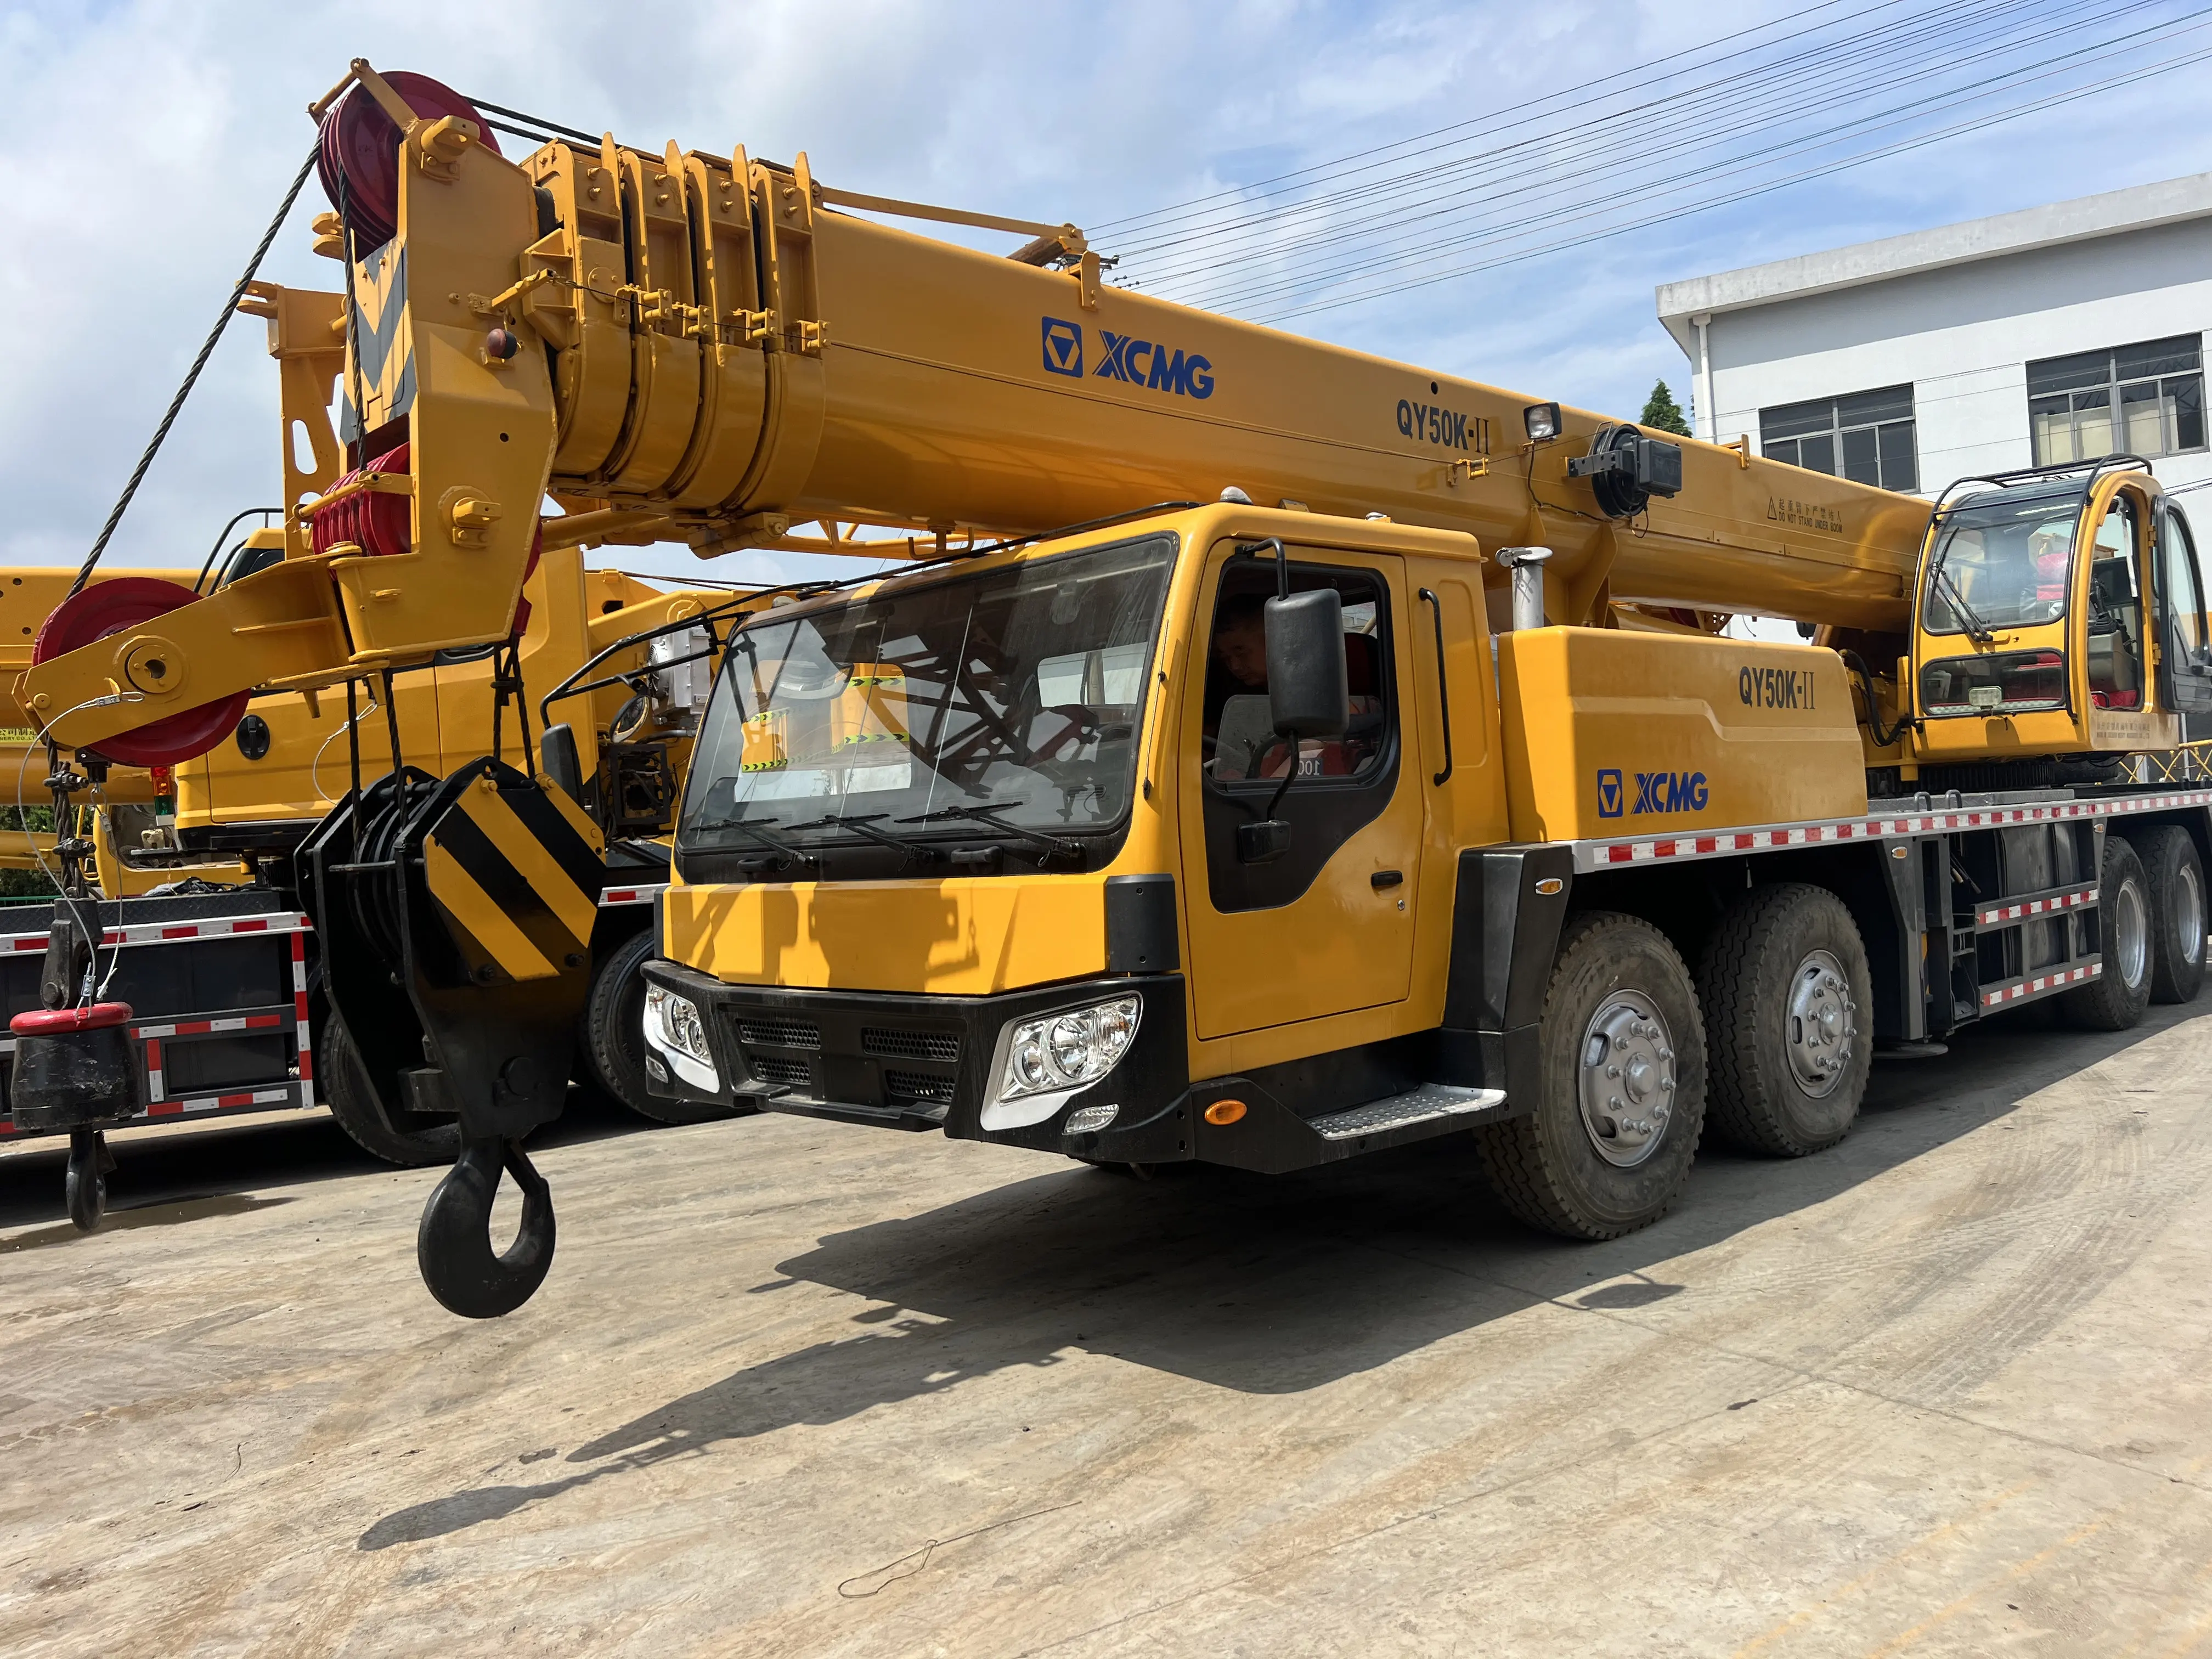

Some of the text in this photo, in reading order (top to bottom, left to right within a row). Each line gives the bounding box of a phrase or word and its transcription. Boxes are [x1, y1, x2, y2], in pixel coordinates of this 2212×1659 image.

[1092, 329, 1214, 399] XCMG
[1779, 511, 1842, 533] DO NOT STAND UNDER BOOM
[1630, 772, 1708, 815] XCMG
